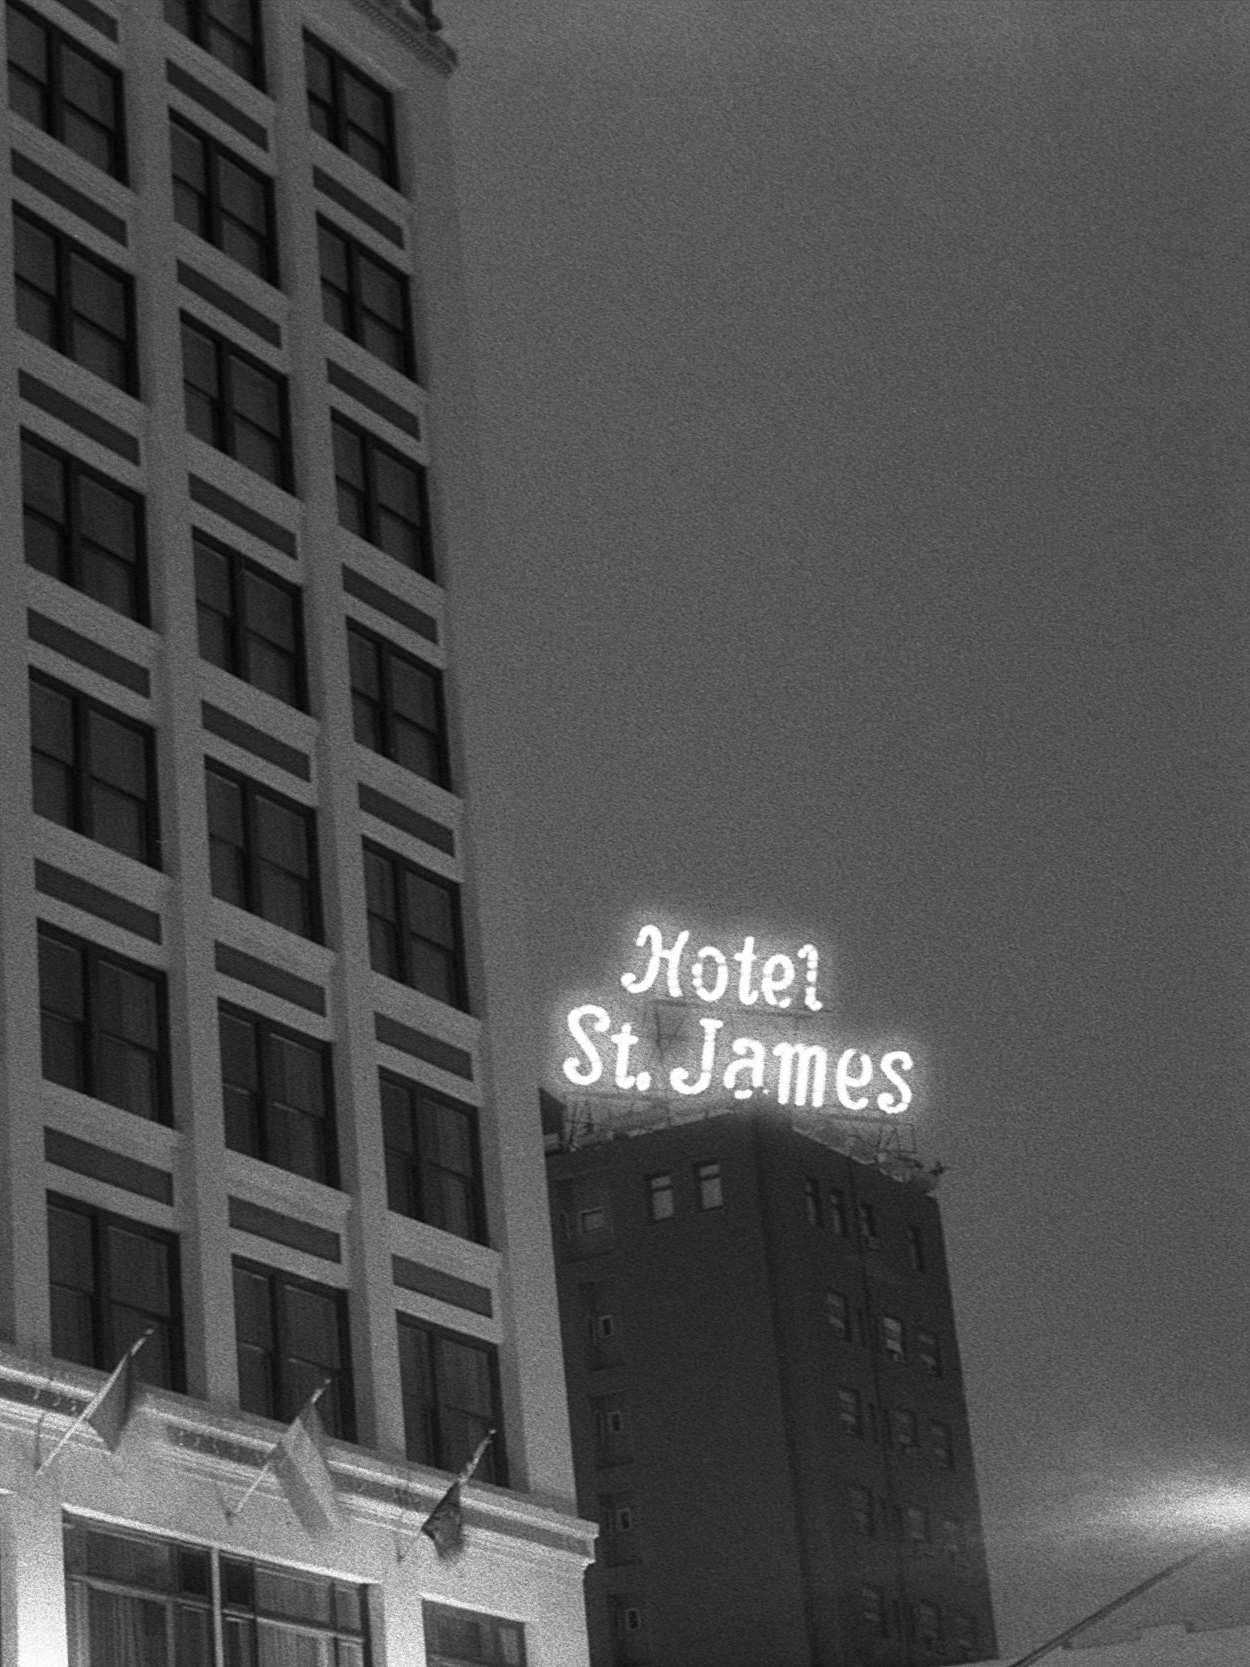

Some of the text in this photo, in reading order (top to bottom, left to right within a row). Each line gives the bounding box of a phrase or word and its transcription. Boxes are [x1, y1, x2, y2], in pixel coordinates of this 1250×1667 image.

[620, 924, 823, 1012] Hotel
[562, 1003, 915, 1115] St. James
